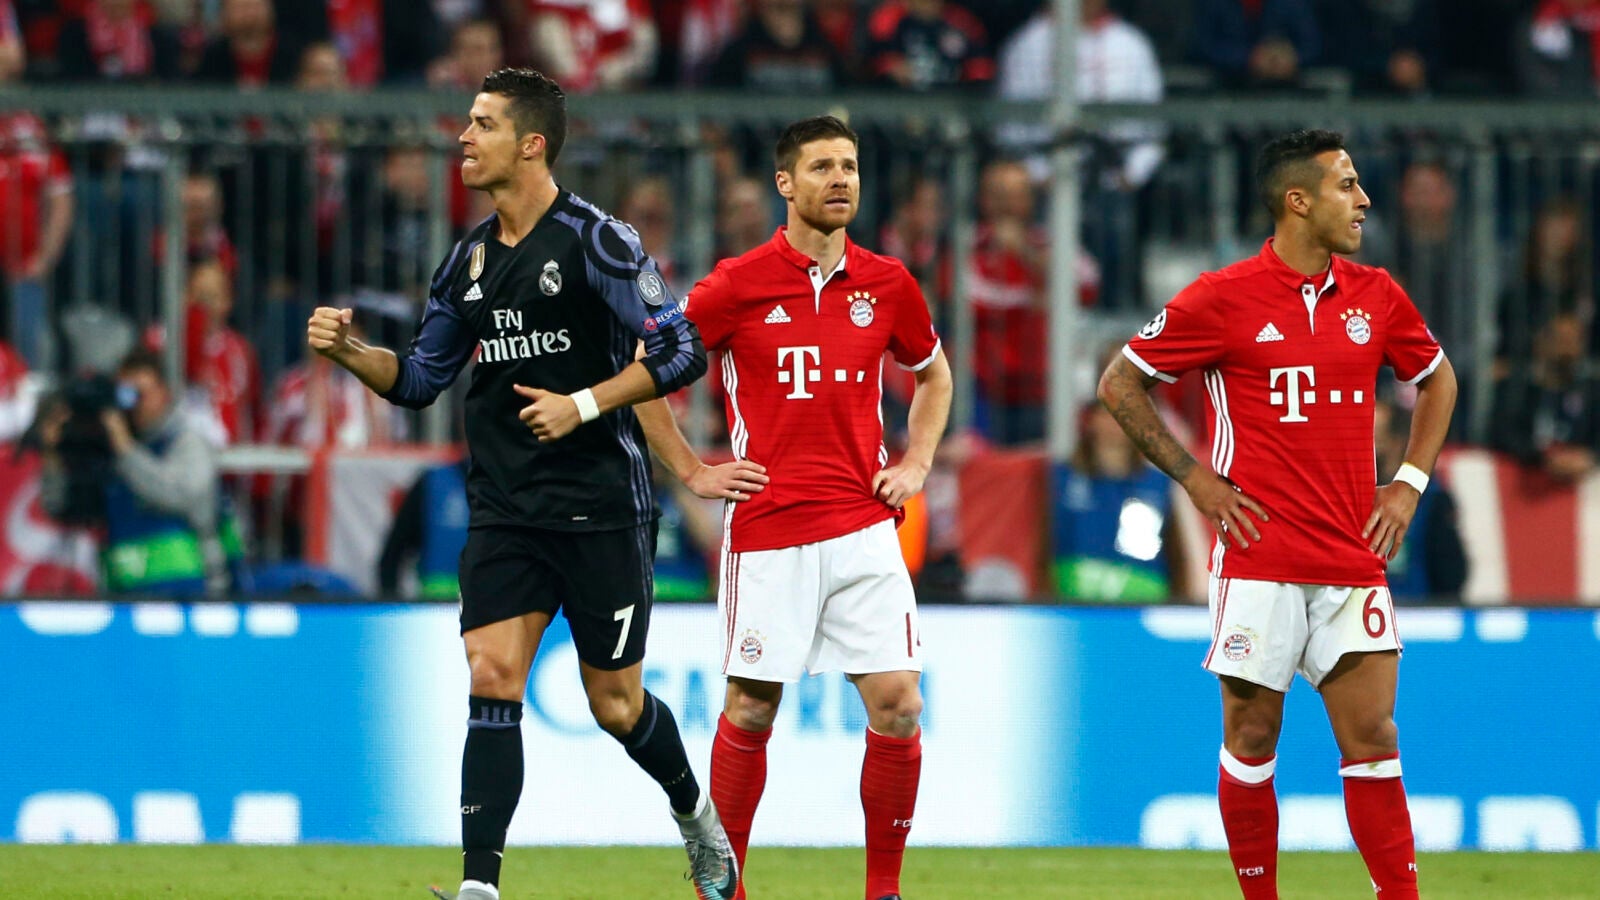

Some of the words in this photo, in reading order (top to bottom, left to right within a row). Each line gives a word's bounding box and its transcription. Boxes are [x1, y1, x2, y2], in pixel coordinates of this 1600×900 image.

[492, 309, 523, 331] Fly
[655, 306, 682, 324] RESPEC
[478, 329, 571, 363] mirates
[1362, 589, 1386, 638] 6
[611, 604, 635, 660] 7
[905, 612, 921, 658] 1
[461, 805, 481, 815] CF
[893, 819, 912, 828] FC
[1239, 866, 1264, 876] FCB
